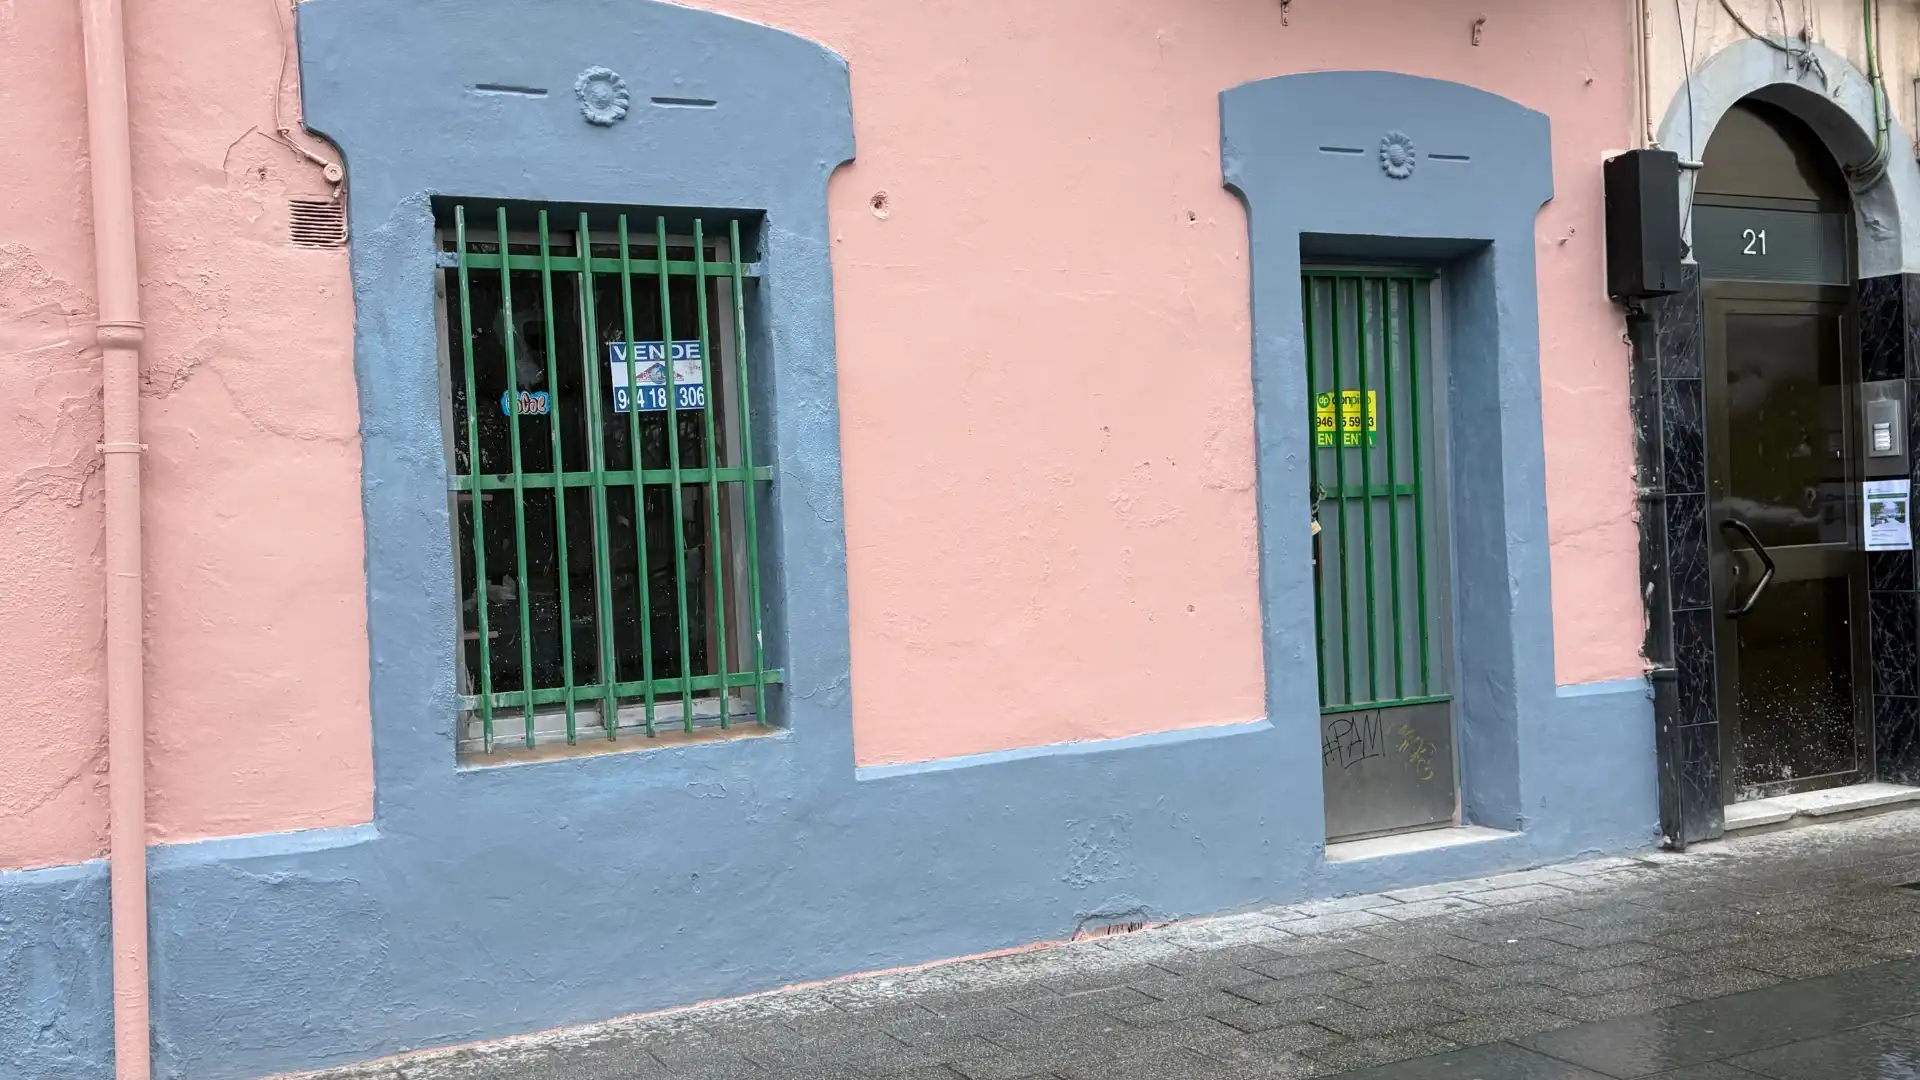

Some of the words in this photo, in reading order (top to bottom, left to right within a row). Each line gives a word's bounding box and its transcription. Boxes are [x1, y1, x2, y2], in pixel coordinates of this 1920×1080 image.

[1743, 228, 1766, 255] 21
[613, 343, 701, 361] VENDE
[617, 388, 645, 409] 94
[679, 386, 705, 407] 306
[1316, 416, 1333, 427] 946
[1317, 433, 1333, 445] EN
